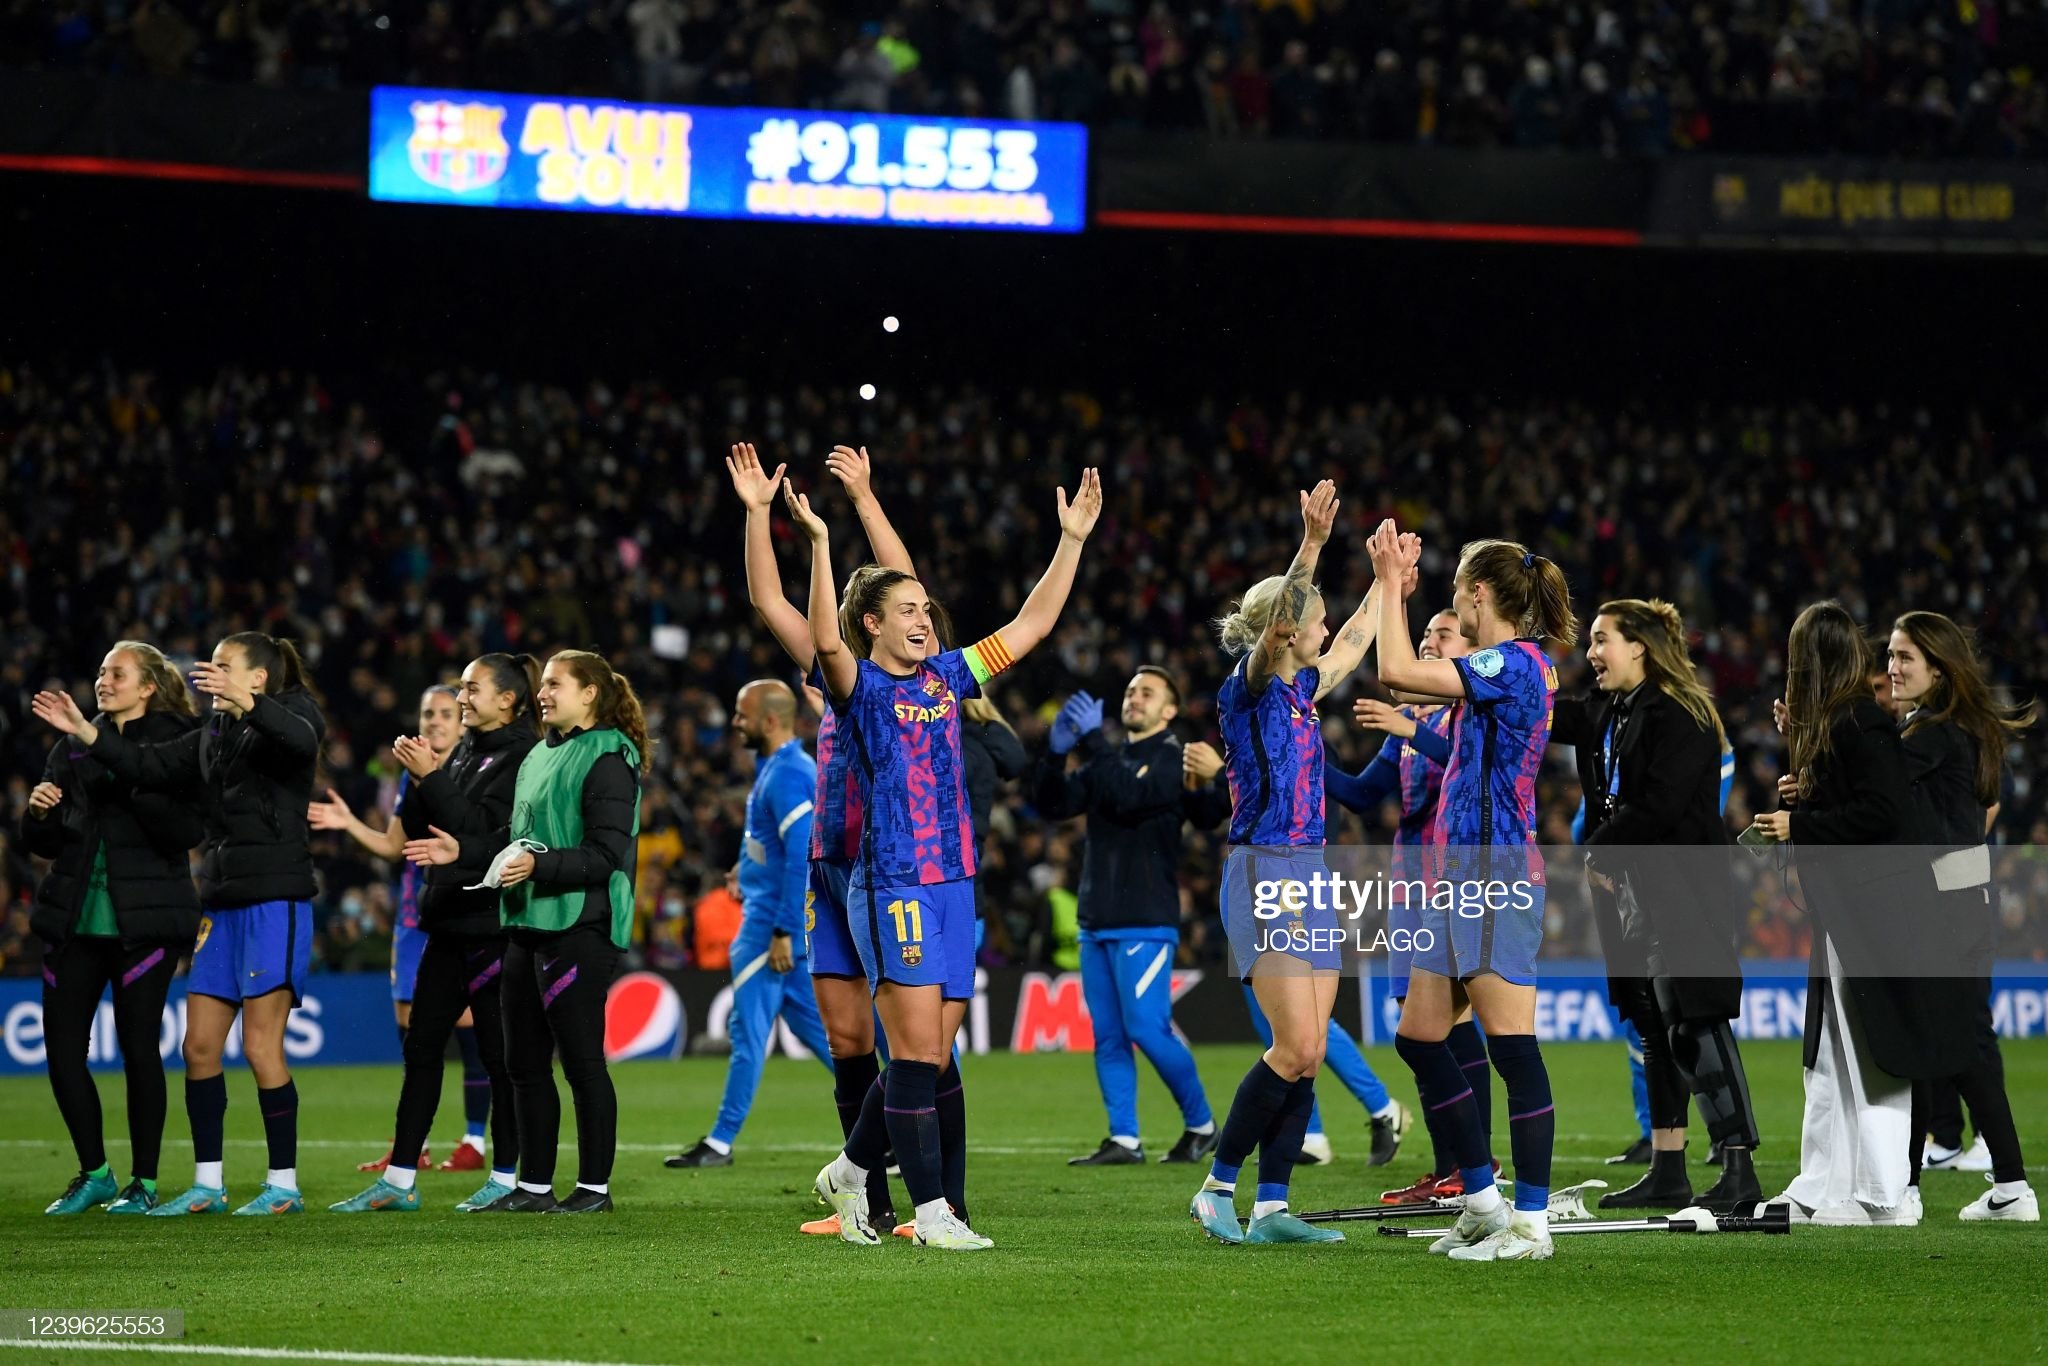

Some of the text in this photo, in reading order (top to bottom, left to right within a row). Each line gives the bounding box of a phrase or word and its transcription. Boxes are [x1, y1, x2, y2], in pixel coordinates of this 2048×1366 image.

[519, 103, 693, 156] AVUI
[746, 118, 1038, 192] #91.553
[536, 150, 690, 211] SOM
[887, 899, 923, 942] 11
[1536, 991, 1613, 1041] EFA
